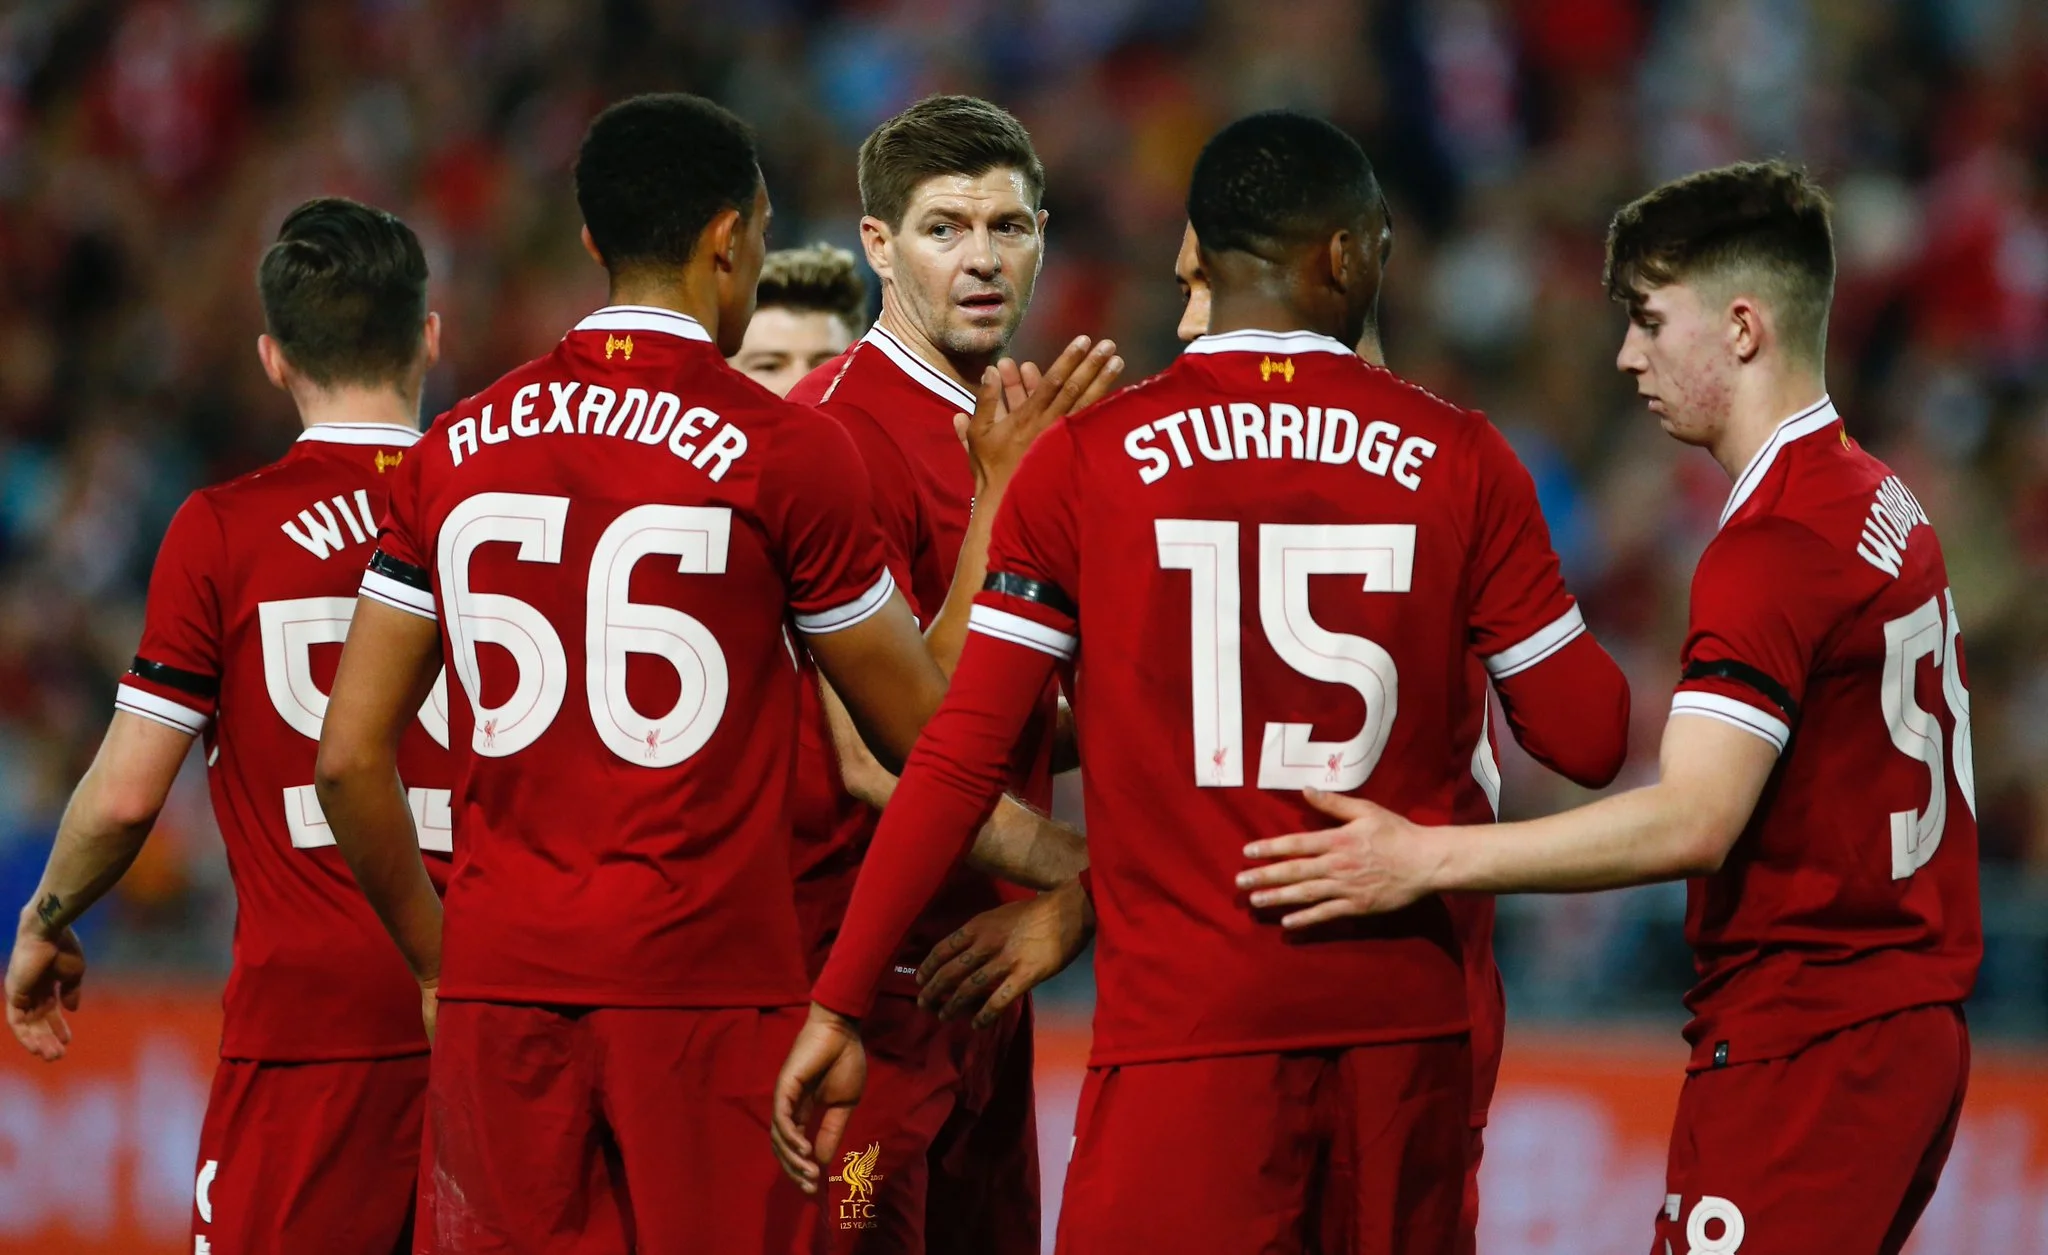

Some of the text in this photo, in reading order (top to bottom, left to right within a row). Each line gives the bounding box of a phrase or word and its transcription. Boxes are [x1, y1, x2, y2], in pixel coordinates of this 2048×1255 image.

[448, 382, 748, 482] ALEXANDER
[1124, 402, 1437, 491] STURRIDGE
[437, 492, 732, 767] 66
[1155, 519, 1416, 790] 15
[840, 1222, 852, 1230] 125
